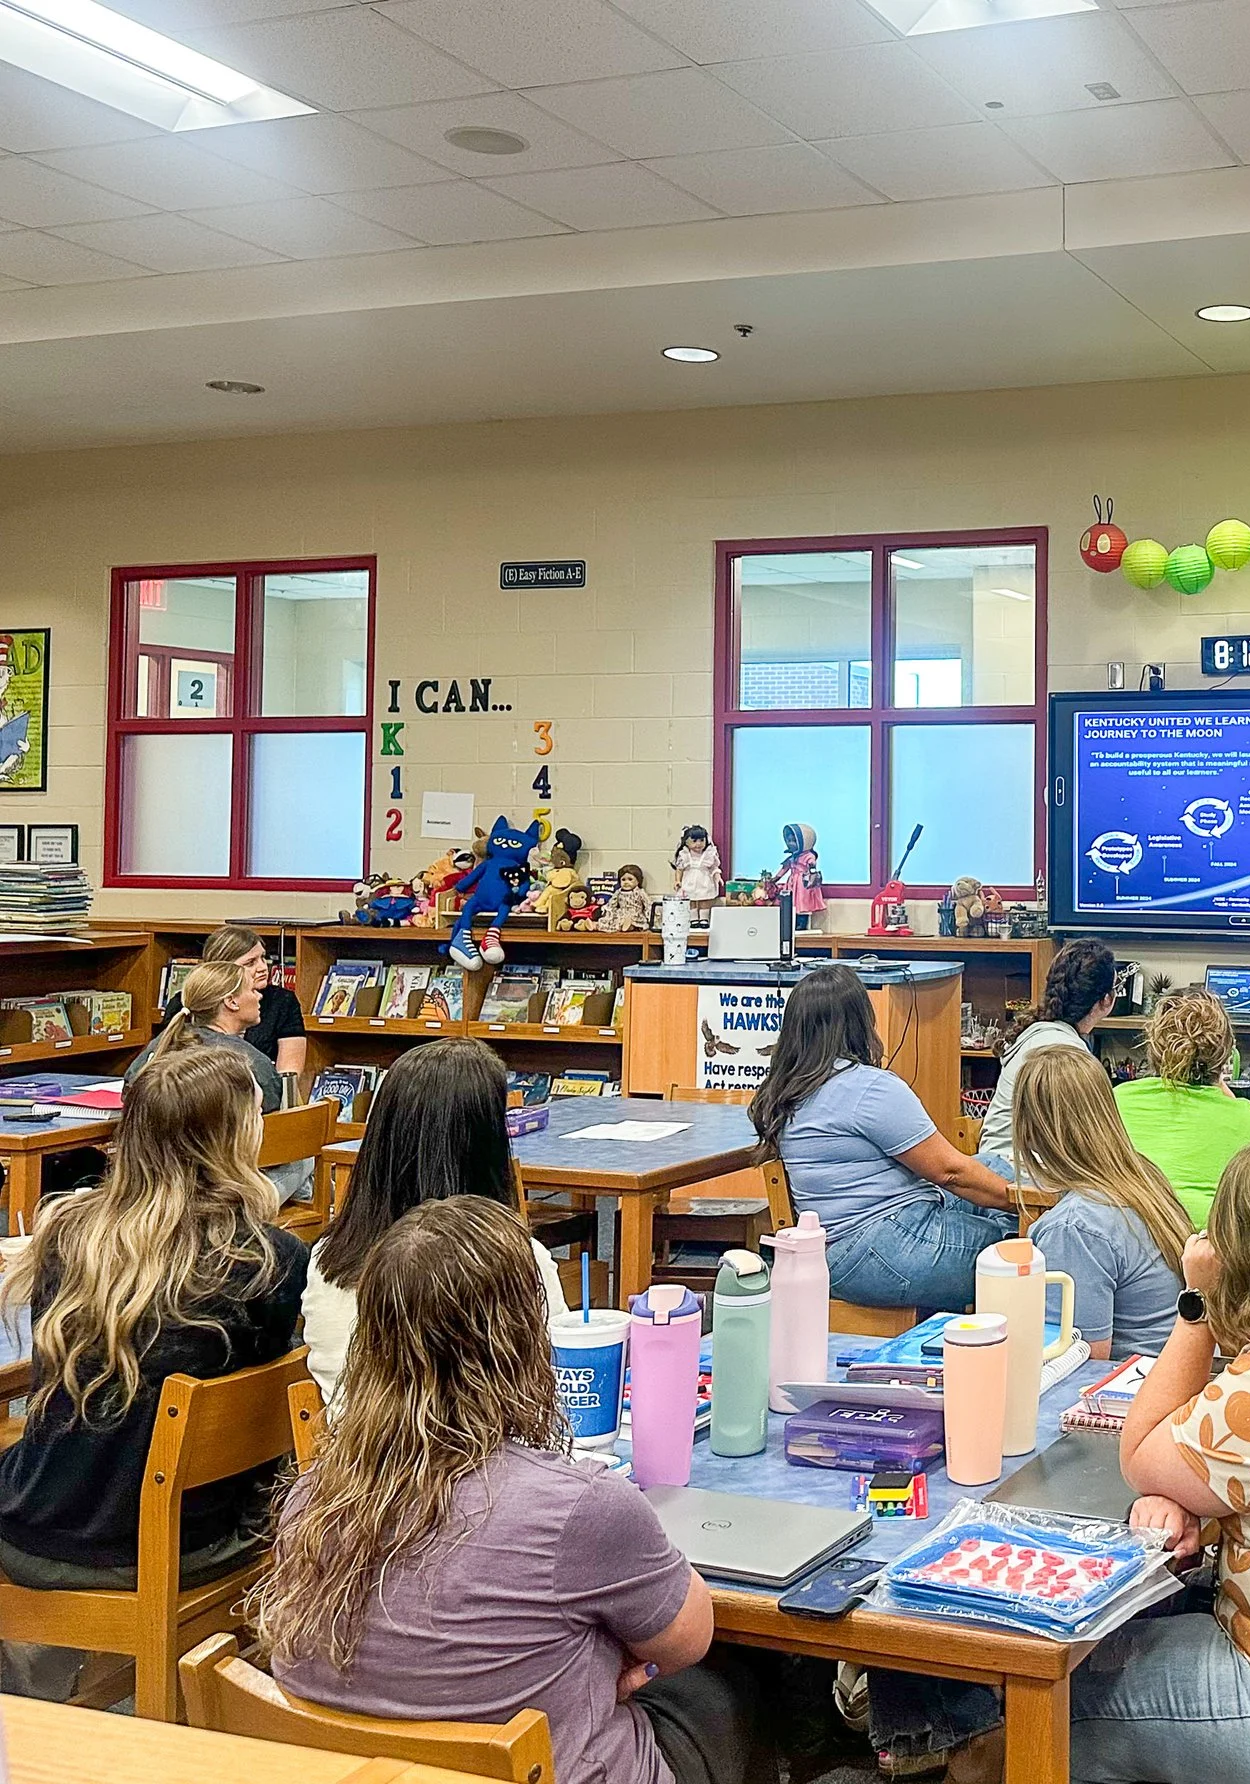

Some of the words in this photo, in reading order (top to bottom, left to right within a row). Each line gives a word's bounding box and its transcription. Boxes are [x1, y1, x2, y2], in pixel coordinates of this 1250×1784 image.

[504, 568, 518, 583] (E)
[519, 568, 537, 583] Easy
[538, 567, 565, 580] Fiction
[566, 567, 581, 580] A-E
[190, 679, 204, 700] 2
[388, 680, 401, 713] I
[415, 678, 513, 714] CAN...
[1084, 718, 1146, 727] KENTUCKY
[1149, 717, 1192, 727] UNITED
[1194, 716, 1213, 726] WE
[380, 722, 405, 756] K
[534, 721, 554, 756] 3
[1084, 730, 1139, 739] JOURNEY
[1141, 730, 1157, 738] TO
[1159, 729, 1183, 738] THE
[1186, 728, 1223, 738] MOON
[1100, 760, 1151, 769] accountability
[1152, 761, 1180, 769] system
[1181, 760, 1196, 768] that
[1206, 760, 1248, 768] meaningful
[1174, 752, 1211, 760] Kentucky,
[390, 766, 403, 800] 1
[532, 764, 552, 800] 4
[386, 808, 403, 842] 2
[533, 808, 552, 842] 5
[720, 992, 739, 1007] We
[741, 996, 763, 1008] are
[766, 994, 786, 1009] the
[704, 1061, 736, 1076] Have
[738, 1064, 771, 1080] respe
[556, 1368, 594, 1381] TAYS
[560, 1382, 588, 1394] OLD
[565, 1395, 598, 1407] GER
